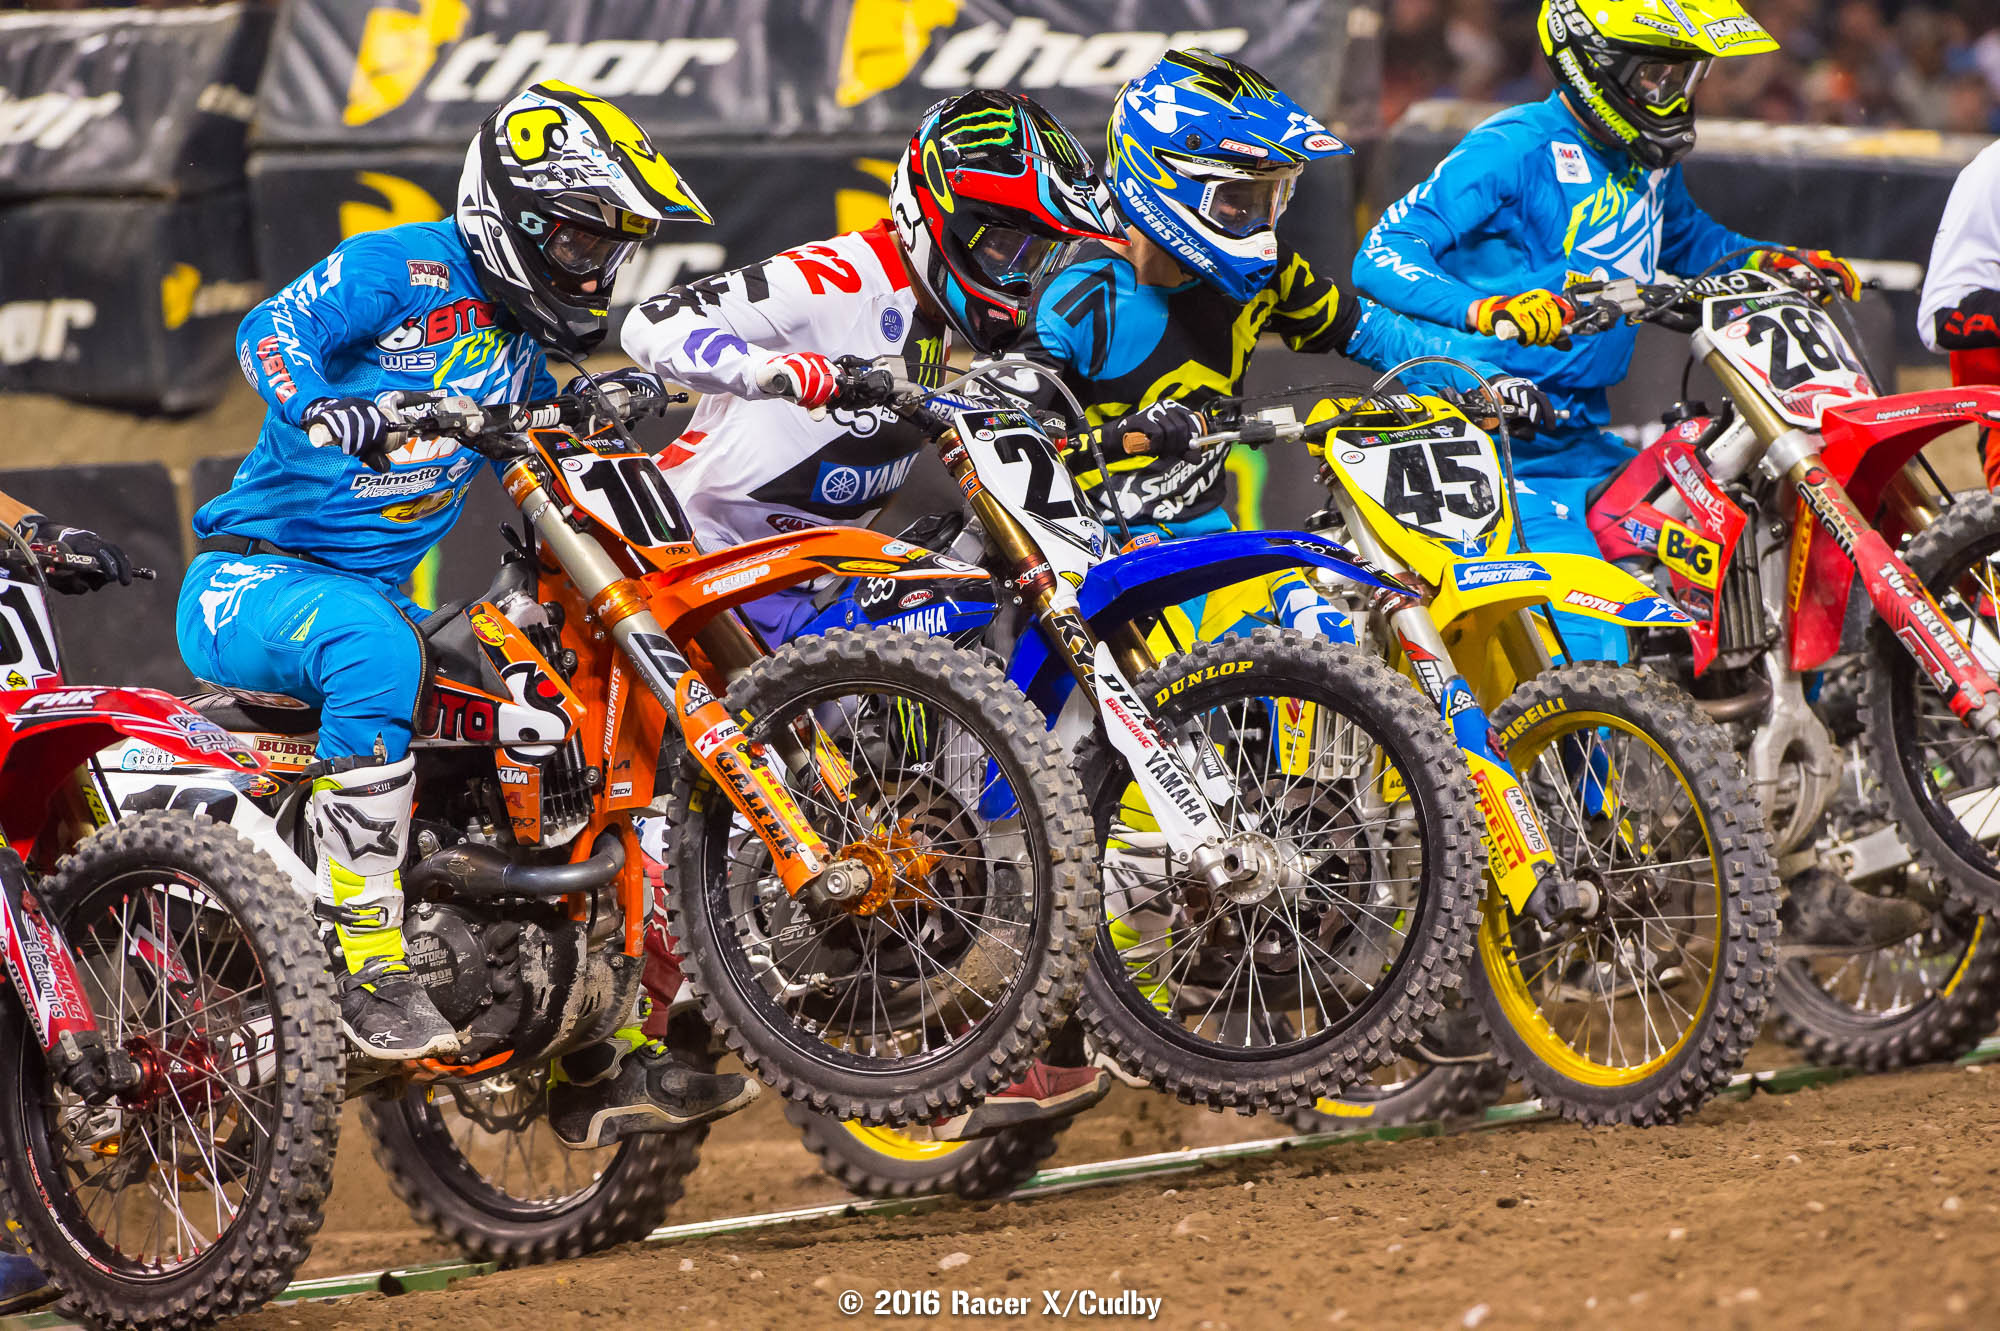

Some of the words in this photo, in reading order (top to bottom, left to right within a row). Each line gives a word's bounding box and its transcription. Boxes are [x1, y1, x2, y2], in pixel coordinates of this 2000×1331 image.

[1311, 138, 1339, 149] BELL
[1141, 194, 1208, 254] MOTORCYCLE
[1201, 187, 1212, 213] OAKLEY
[380, 352, 436, 371] WPS
[1744, 306, 1841, 391] 28
[1390, 427, 1431, 439] MONSTER
[354, 467, 442, 488] Palmetto
[579, 458, 694, 547] 10
[993, 433, 1081, 521] 2
[1383, 439, 1497, 527] 45
[1134, 532, 1159, 547] GET
[1564, 591, 1622, 615] MOTUL
[1909, 599, 1973, 669] SECRET
[603, 666, 621, 755] POWERPARTS
[1154, 660, 1254, 708] DUNLOP
[1104, 697, 1153, 750] BRAKING
[1500, 697, 1568, 751] PIRELLI
[132, 755, 177, 765] SPORTS
[498, 766, 529, 785] KTM
[1144, 750, 1208, 827] YAMAHA
[1508, 789, 1545, 851] HOTCAMS
[9, 960, 49, 1048] DUNLOP
[23, 941, 65, 1018] Electronics
